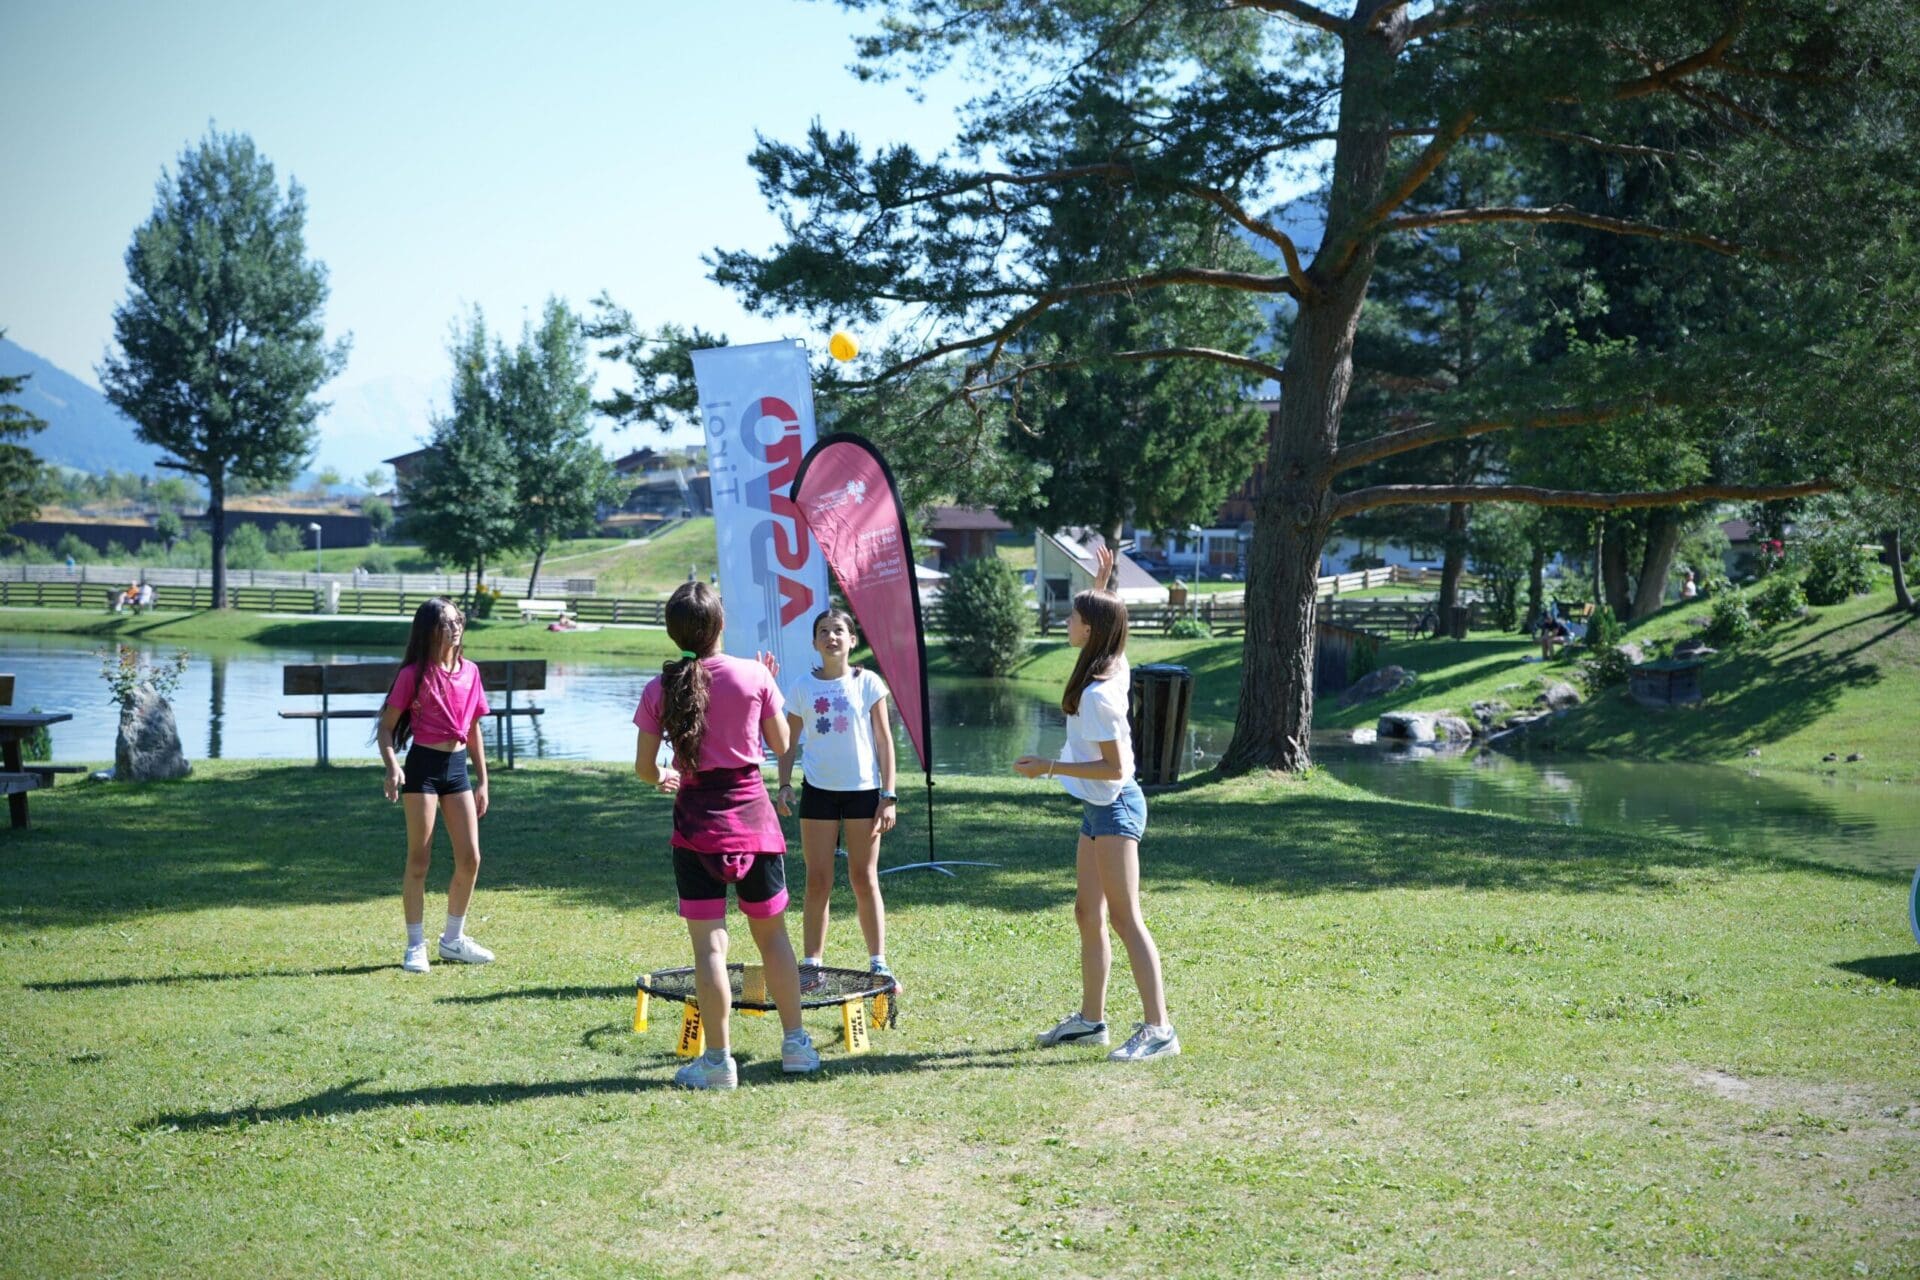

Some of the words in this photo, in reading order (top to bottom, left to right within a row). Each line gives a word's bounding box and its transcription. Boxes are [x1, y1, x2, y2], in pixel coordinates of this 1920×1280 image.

[682, 1018, 692, 1051] SPIKE
[690, 1012, 701, 1041] BALL
[851, 1016, 860, 1048] SPIKE
[856, 1008, 864, 1035] BALL
